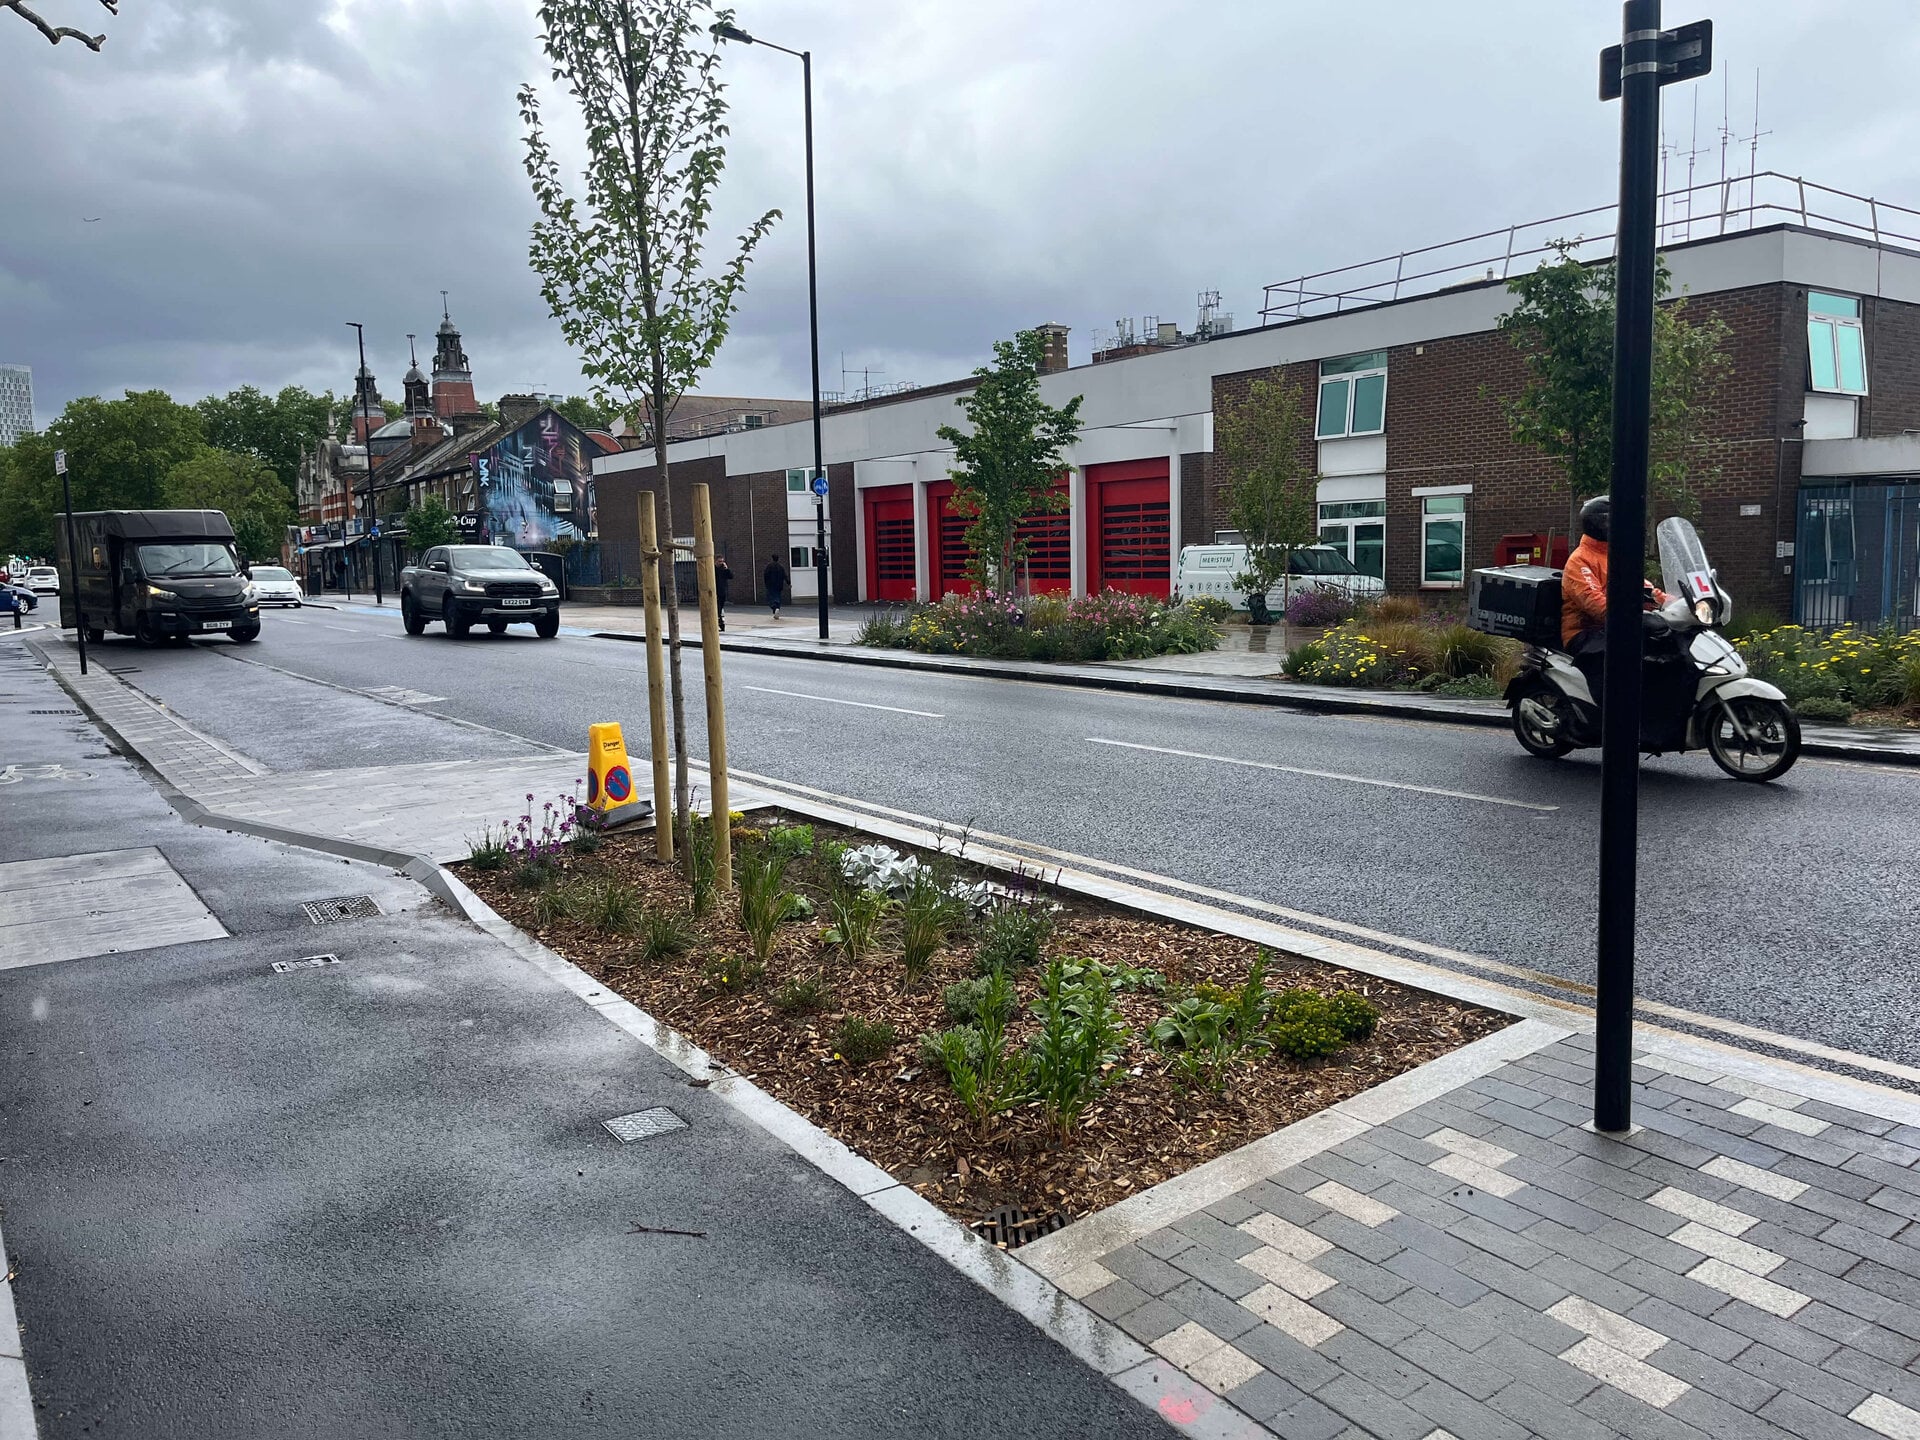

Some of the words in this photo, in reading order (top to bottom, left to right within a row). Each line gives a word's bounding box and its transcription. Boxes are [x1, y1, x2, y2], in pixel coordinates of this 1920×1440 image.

[460, 515, 477, 527] Cup
[1202, 556, 1232, 564] MERISTEM
[1695, 576, 1710, 592] L
[1494, 612, 1526, 626] XFORD
[603, 741, 620, 749] Danger
